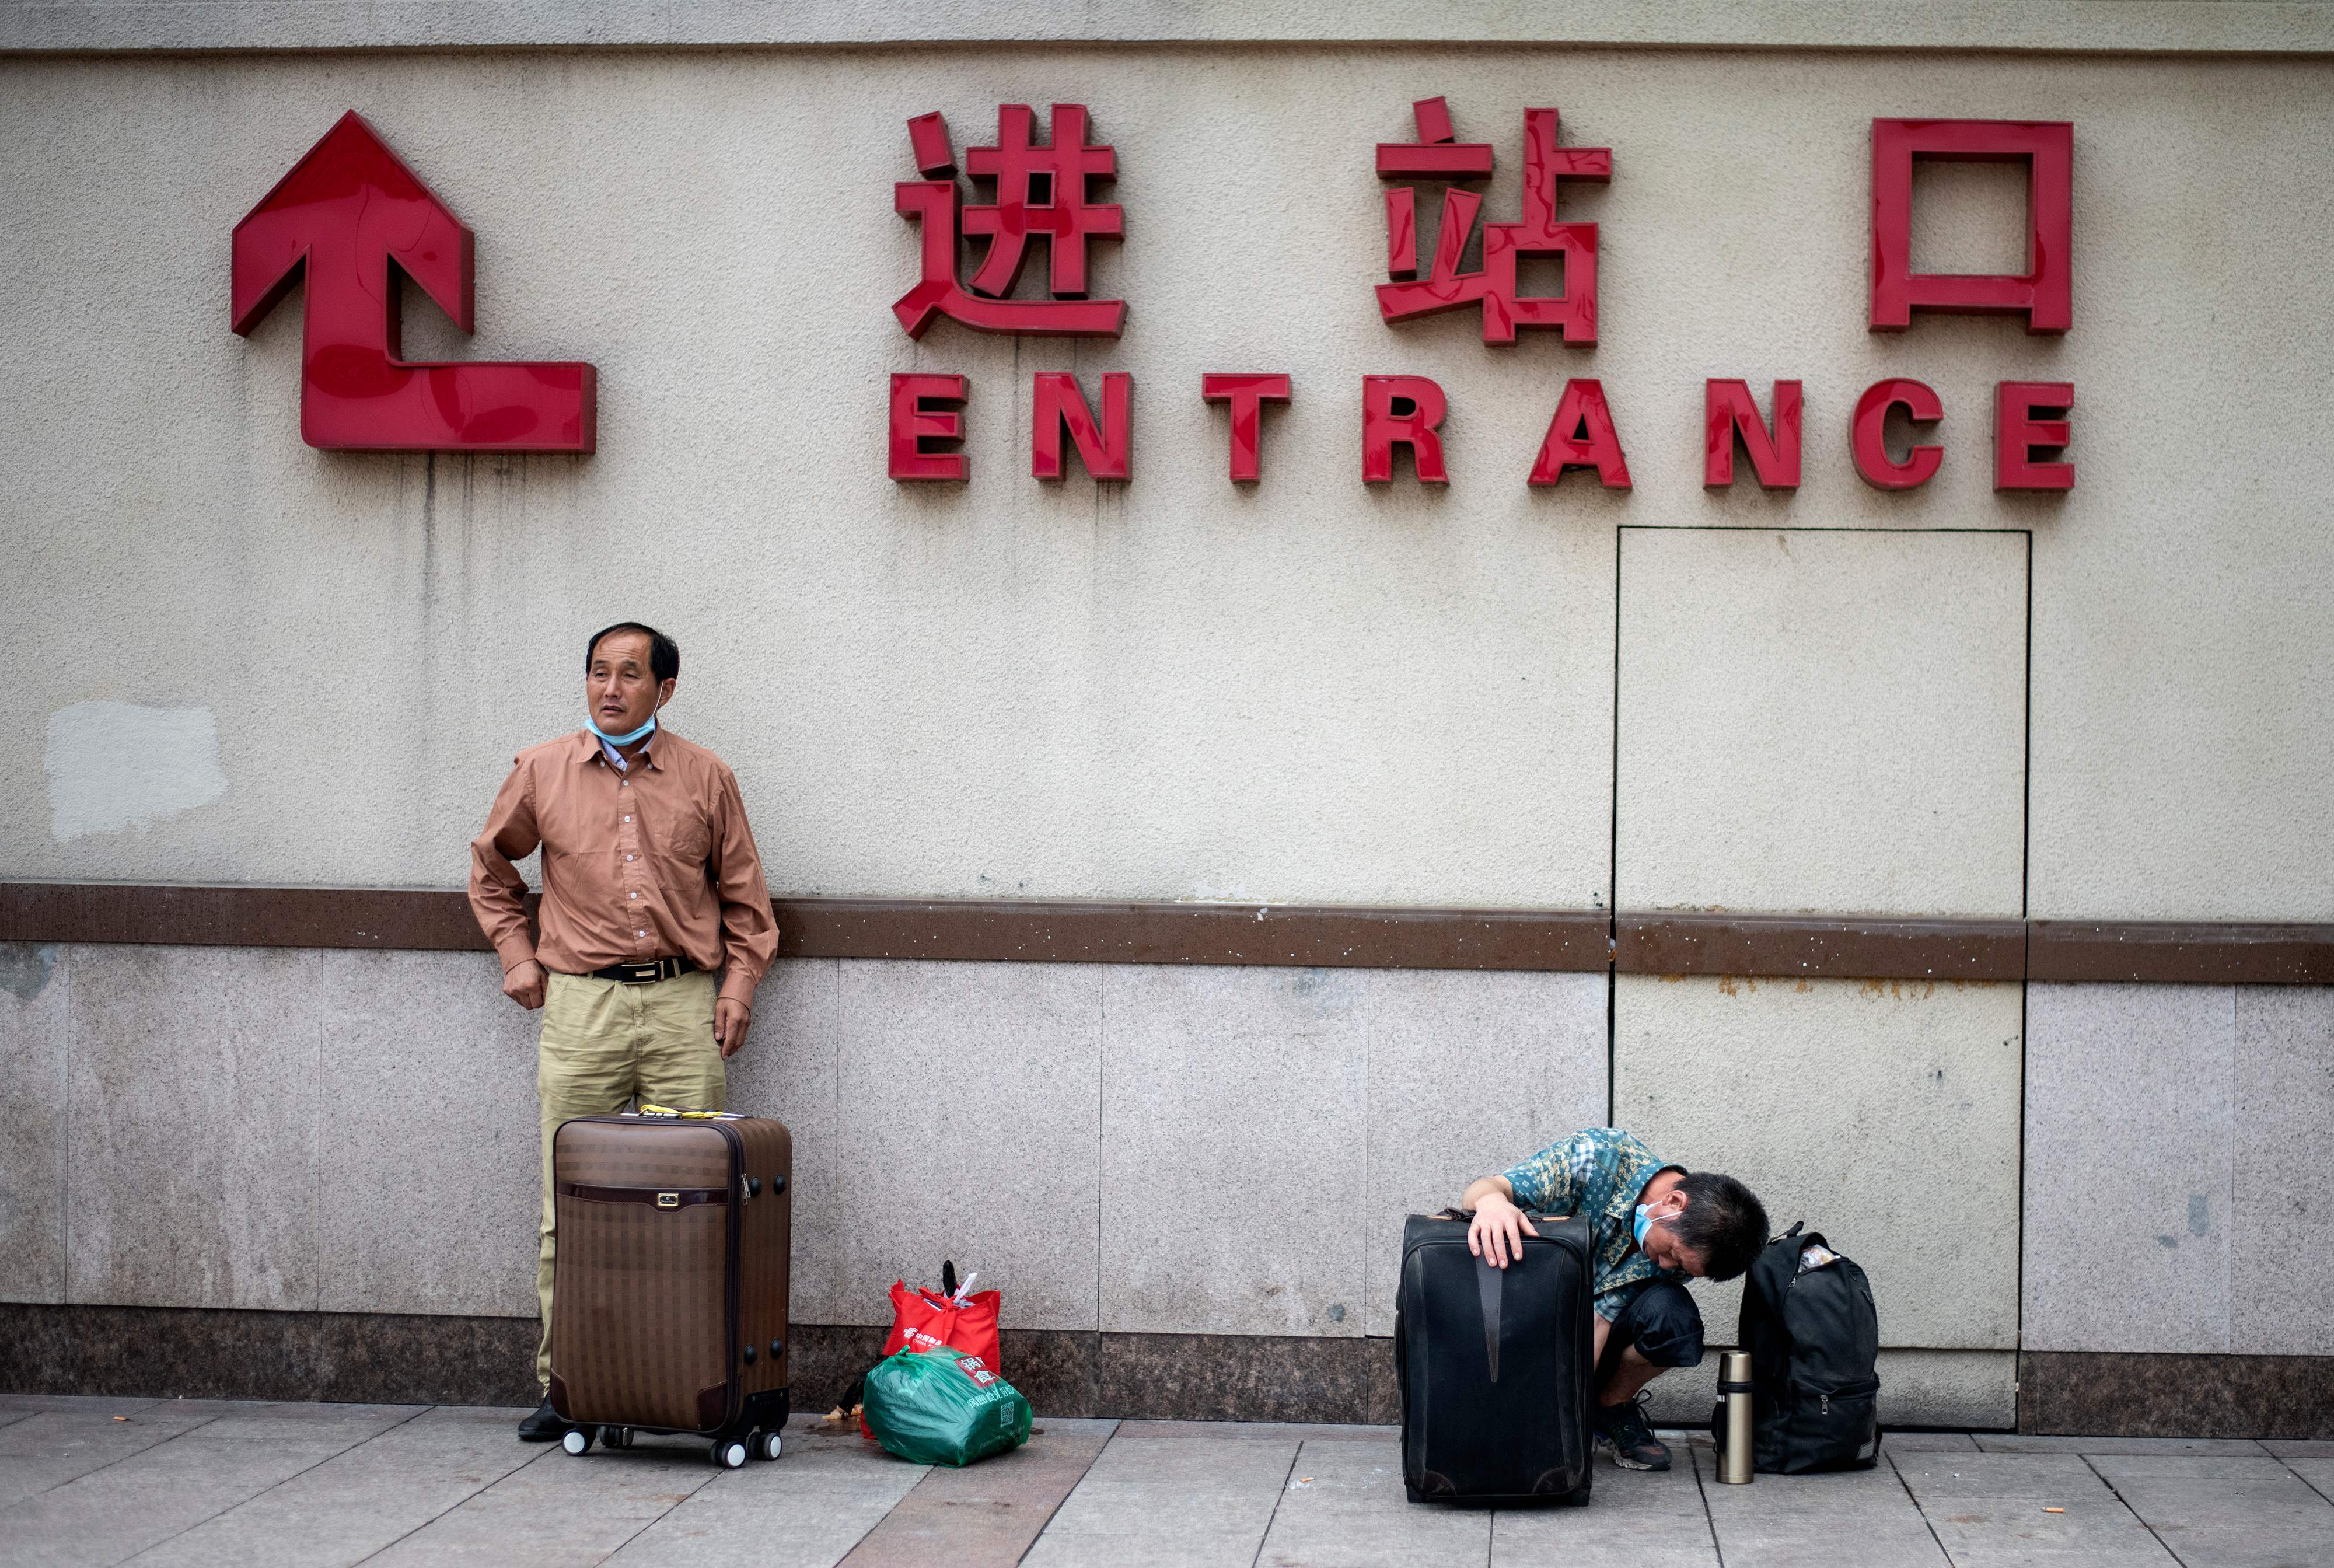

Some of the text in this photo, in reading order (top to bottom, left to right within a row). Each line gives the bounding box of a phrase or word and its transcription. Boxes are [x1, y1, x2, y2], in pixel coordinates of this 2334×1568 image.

[892, 96, 2074, 348] 进站口
[888, 371, 2075, 491] ENTRANCE
